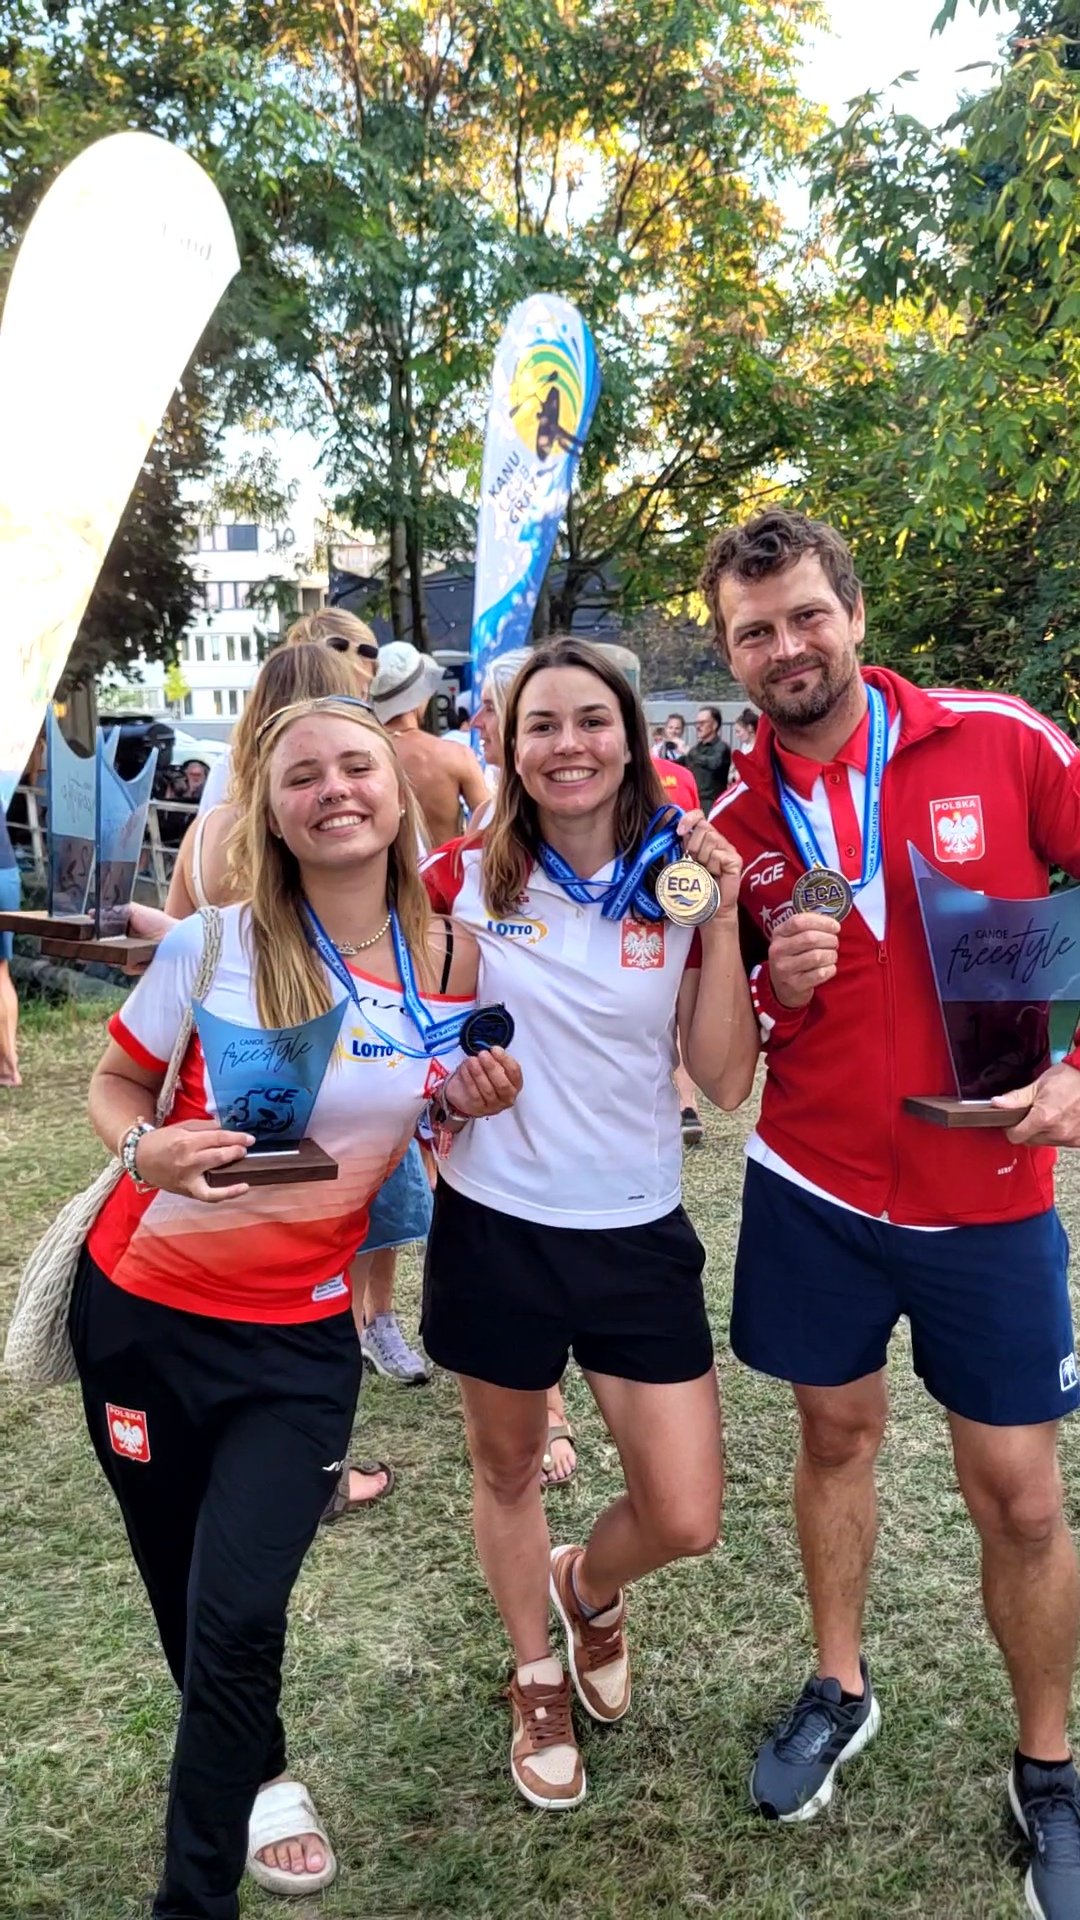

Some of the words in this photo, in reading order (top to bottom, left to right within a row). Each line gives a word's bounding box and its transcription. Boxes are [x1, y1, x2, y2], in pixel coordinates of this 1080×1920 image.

[488, 451, 520, 499] KANU
[873, 746, 881, 786] EUROPEAN
[934, 800, 977, 811] POLSKA
[869, 801, 878, 854] ASSOCIATION
[618, 862, 644, 904] ASSOCIATION
[667, 876, 702, 893] ECA
[750, 861, 785, 893] PGE
[803, 884, 841, 903] ECA
[487, 920, 532, 937] LOTTO
[976, 929, 1009, 939] CANOE
[947, 917, 1076, 985] freestyle
[240, 1038, 264, 1046] CANOE
[352, 1040, 394, 1057] LOTTO
[219, 1030, 314, 1075] freestyle
[108, 1406, 143, 1420] POLSKA
